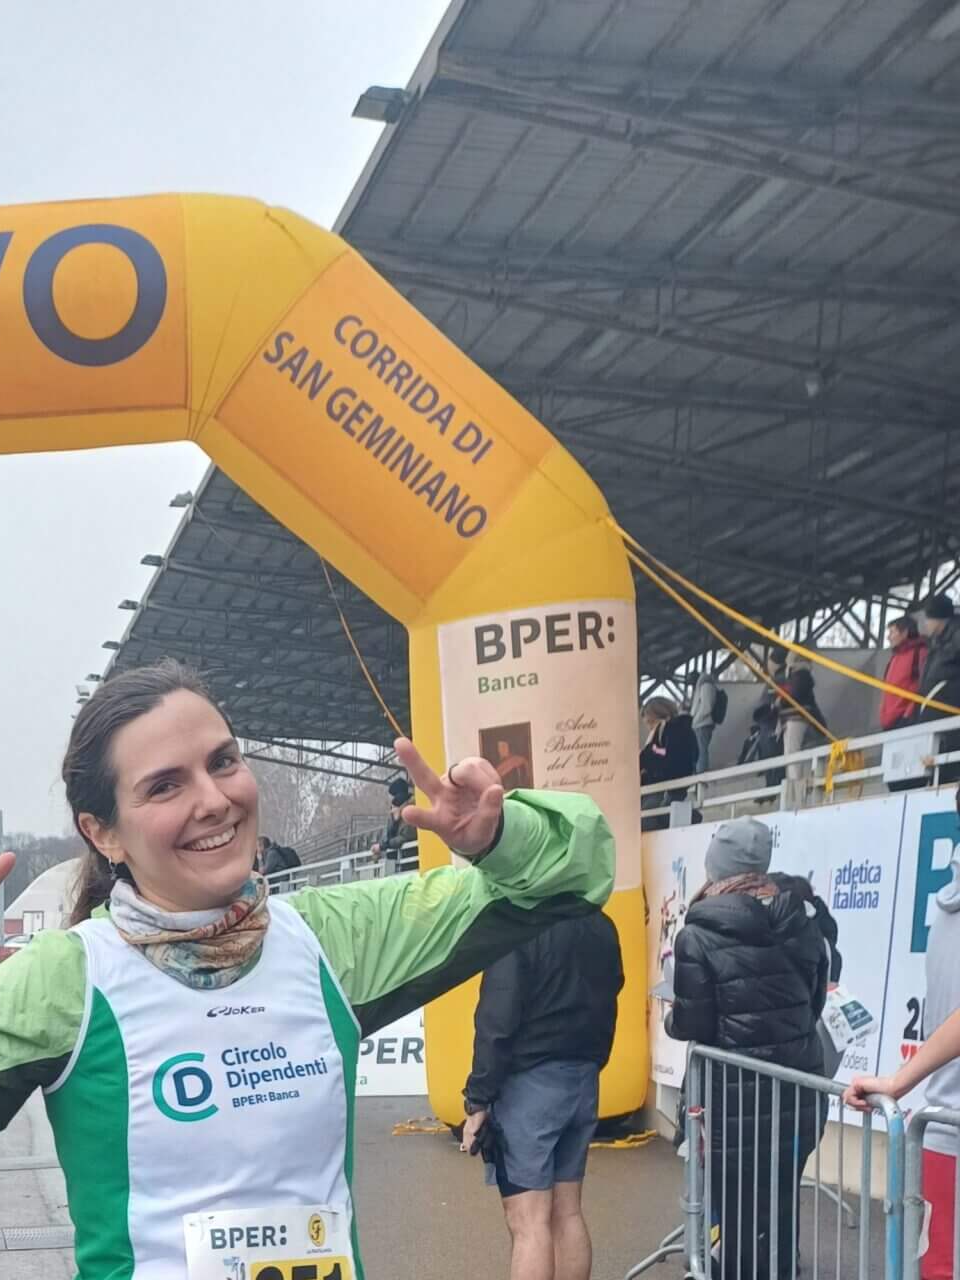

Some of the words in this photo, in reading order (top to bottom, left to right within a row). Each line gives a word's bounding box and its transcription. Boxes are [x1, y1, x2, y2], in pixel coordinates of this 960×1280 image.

[334, 314, 456, 436] CORRIDA
[451, 421, 494, 465] DI
[263, 330, 334, 401] SAN
[325, 386, 488, 538] GEMINIANO
[474, 610, 616, 665] BPER:
[477, 672, 539, 695] Banca
[546, 753, 575, 772] del
[835, 858, 882, 885] atletica
[832, 882, 880, 910] italiana
[221, 1042, 288, 1067] Circolo
[359, 1036, 425, 1065] PER
[226, 1057, 329, 1090] Dipendenti
[210, 1224, 288, 1250] BPER:
